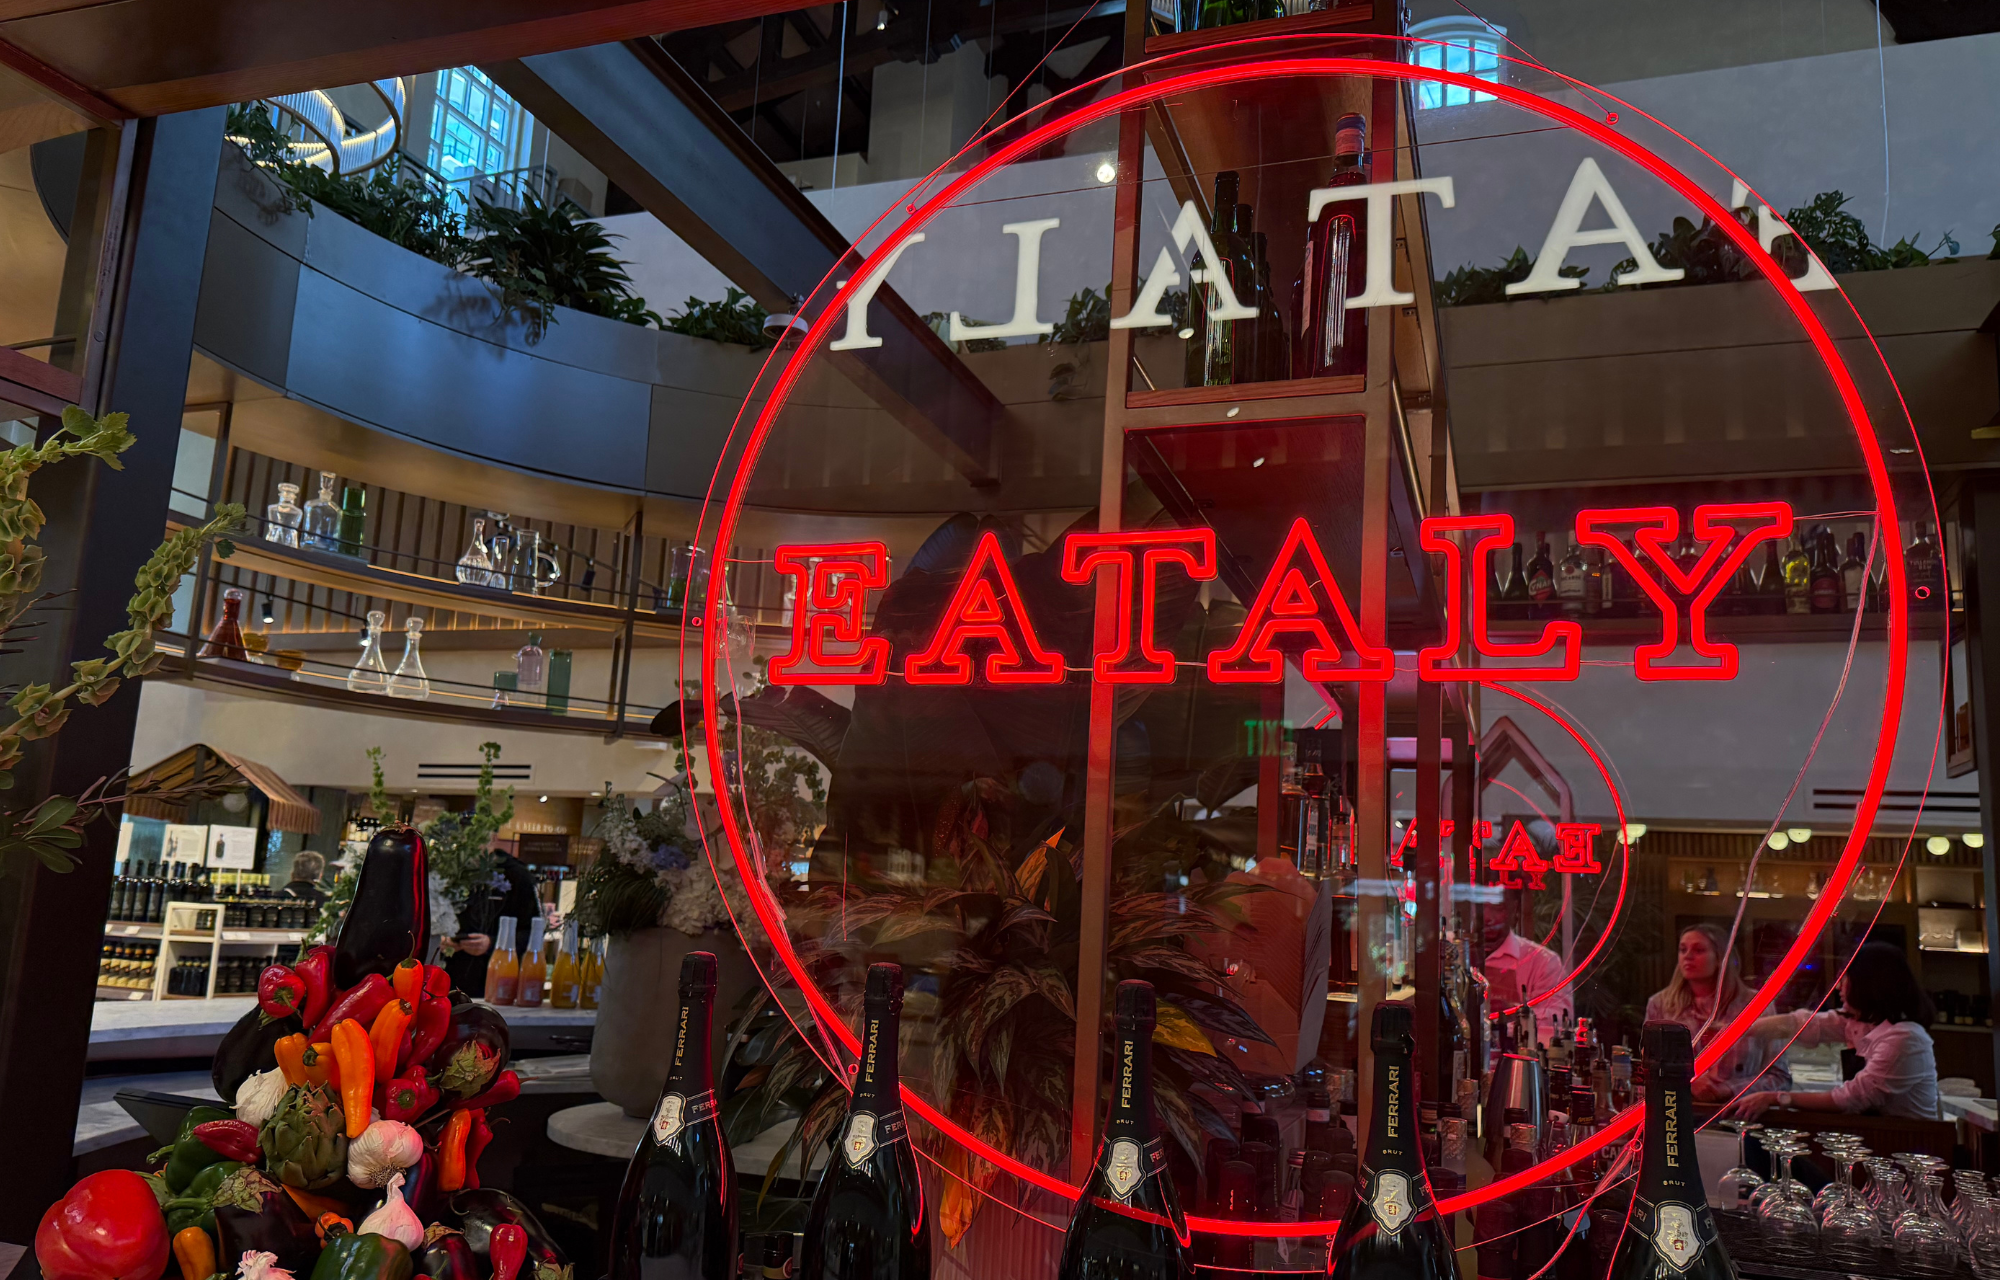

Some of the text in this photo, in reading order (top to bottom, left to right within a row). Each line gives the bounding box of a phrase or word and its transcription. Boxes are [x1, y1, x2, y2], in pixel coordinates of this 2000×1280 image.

[768, 501, 1794, 686] EATALY
[674, 1006, 689, 1066] FERRARI
[865, 1019, 879, 1083] FERRARI
[1121, 1040, 1133, 1108] FERRARI
[1387, 1065, 1400, 1138] FERRARI
[1664, 1090, 1679, 1167] FERRARI
